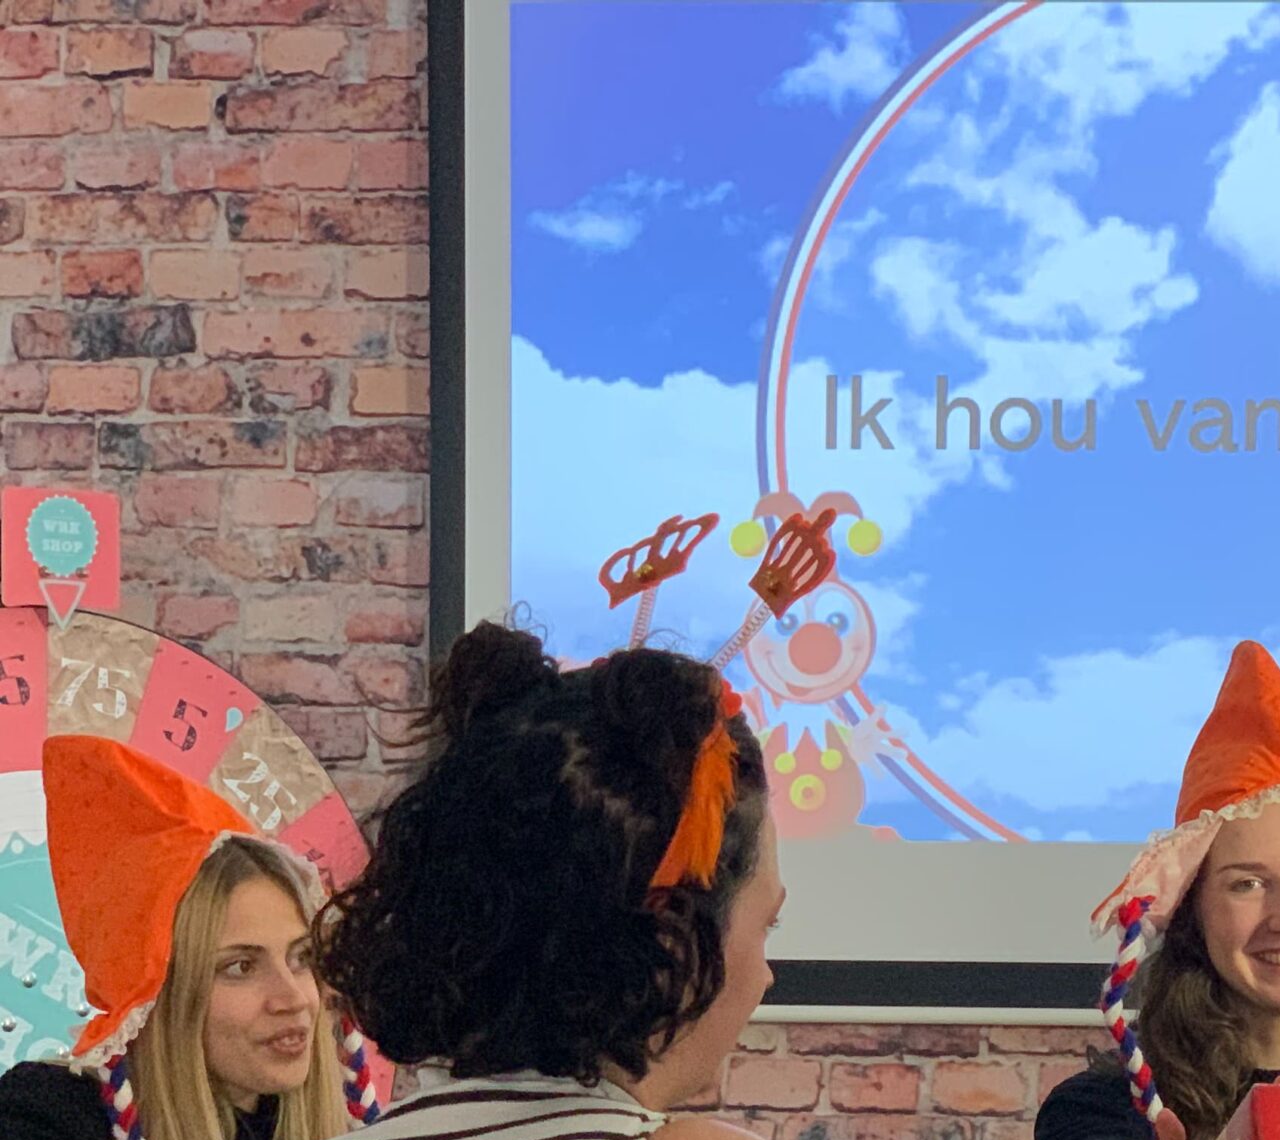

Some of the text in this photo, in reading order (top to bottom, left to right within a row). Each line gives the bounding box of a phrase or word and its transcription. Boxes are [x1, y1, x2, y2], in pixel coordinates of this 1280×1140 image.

[825, 375, 895, 450] Ik
[935, 375, 1097, 452] hou
[41, 538, 84, 554] SHOP
[56, 657, 132, 719] 75
[163, 698, 208, 751] 5
[222, 751, 298, 831] 25
[0, 912, 88, 1012] WR
